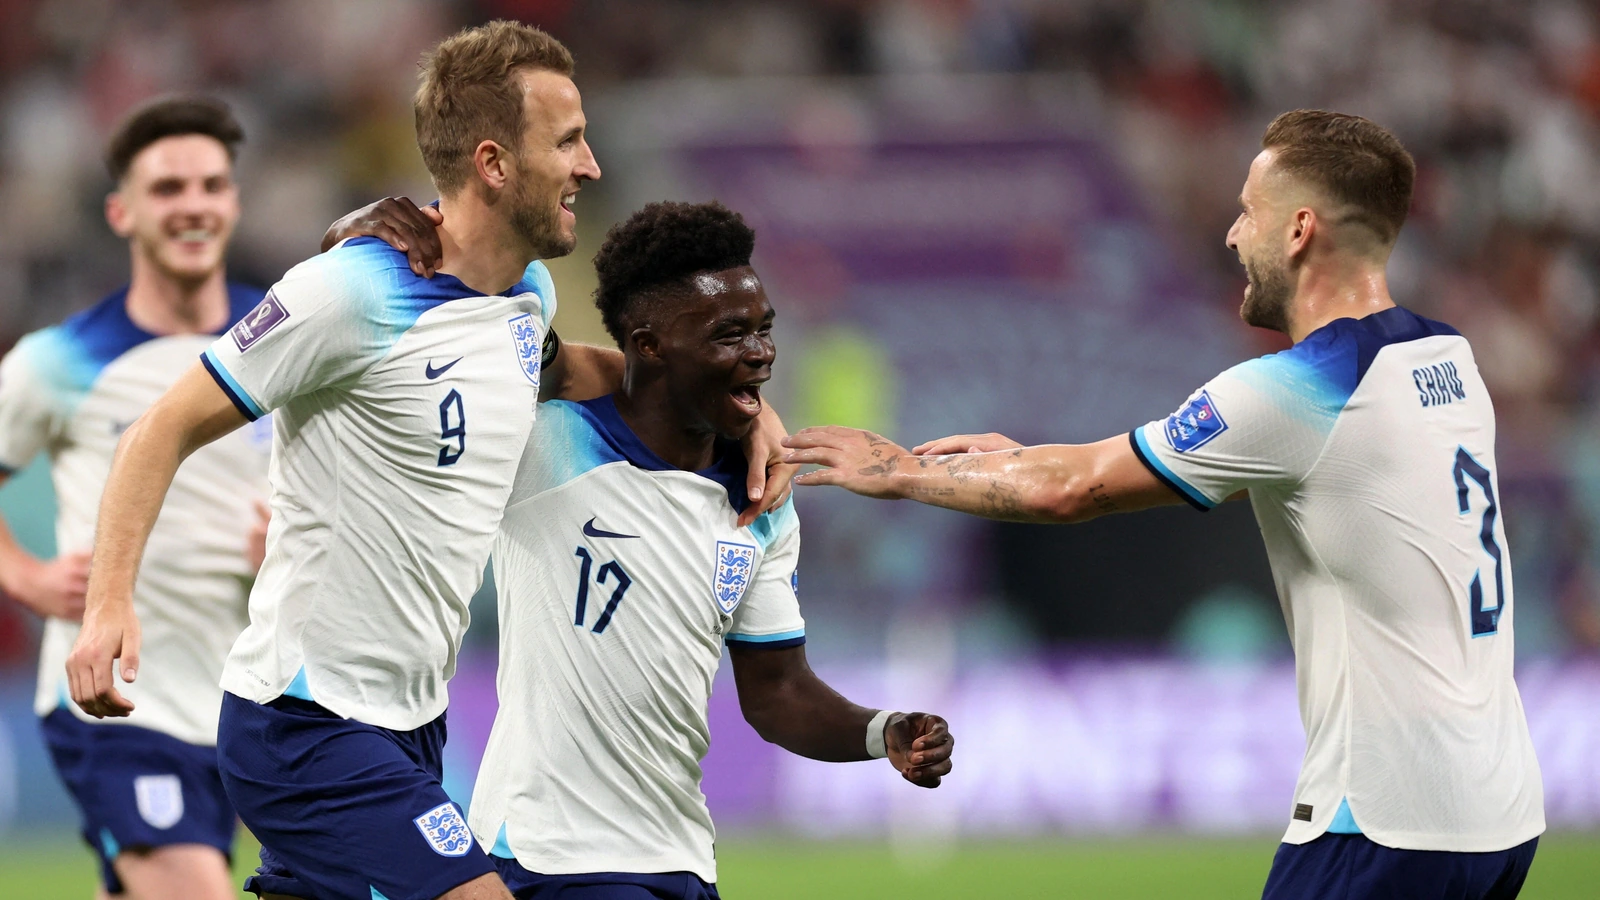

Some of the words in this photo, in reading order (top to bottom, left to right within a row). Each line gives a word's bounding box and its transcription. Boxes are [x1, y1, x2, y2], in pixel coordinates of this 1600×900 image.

[1412, 360, 1466, 407] SHAW
[437, 387, 466, 467] 9
[1451, 444, 1505, 639] 3
[574, 545, 632, 635] 17
